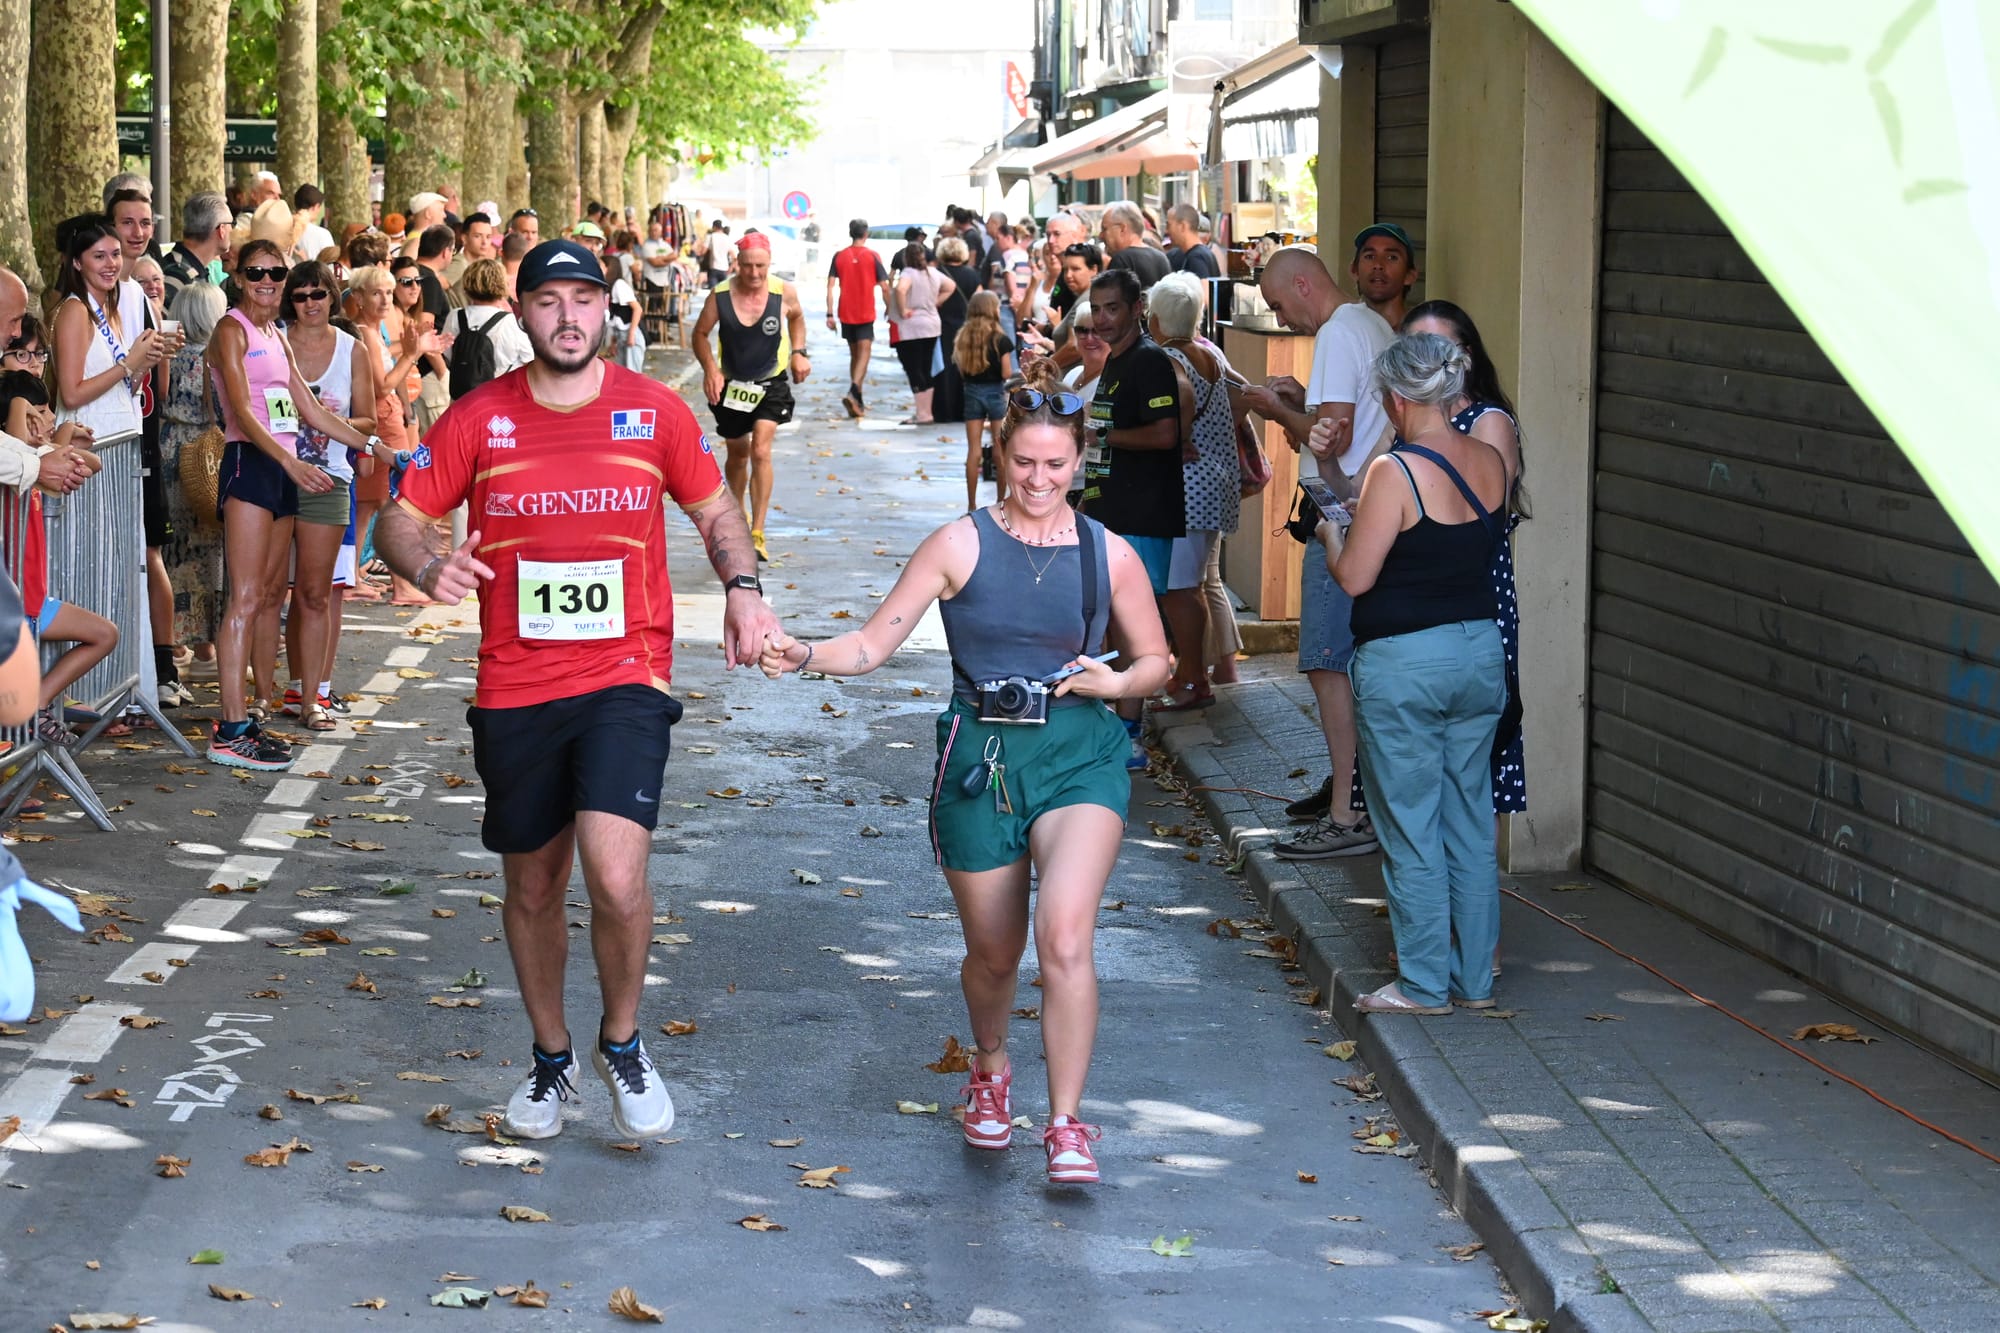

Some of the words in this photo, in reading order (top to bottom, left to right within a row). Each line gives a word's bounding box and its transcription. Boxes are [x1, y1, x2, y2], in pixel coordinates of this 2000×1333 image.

[732, 388, 759, 404] 100
[613, 425, 653, 438] FRANCE
[517, 485, 652, 517] GENERALI
[534, 582, 609, 614] 130
